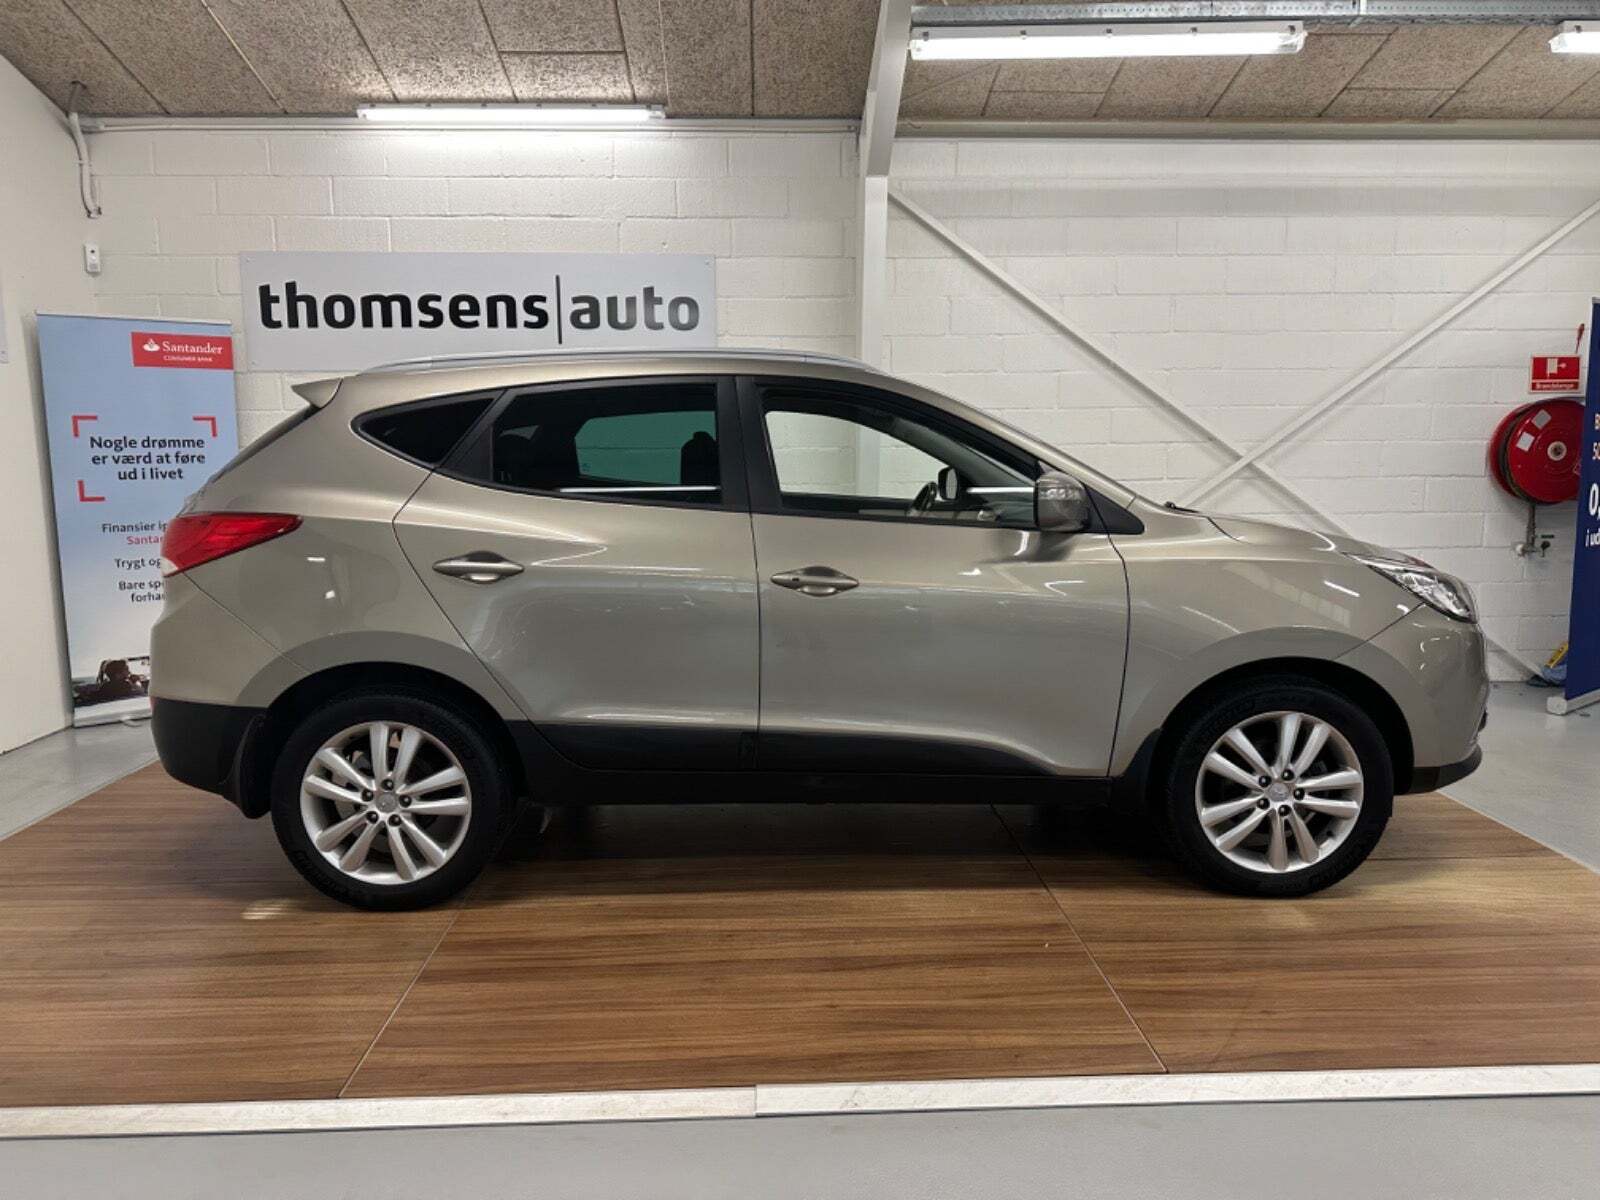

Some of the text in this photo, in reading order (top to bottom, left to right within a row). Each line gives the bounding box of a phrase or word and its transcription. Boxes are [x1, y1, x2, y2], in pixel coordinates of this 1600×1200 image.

[259, 281, 700, 331] thomsens auto
[162, 340, 223, 355] Santander
[89, 435, 206, 451] Nogle drømme
[91, 451, 206, 465] er værd at føre
[118, 467, 184, 480] ud i livet
[102, 522, 155, 533] Finansier
[114, 558, 146, 570] Trygt
[119, 580, 145, 591] Bare
